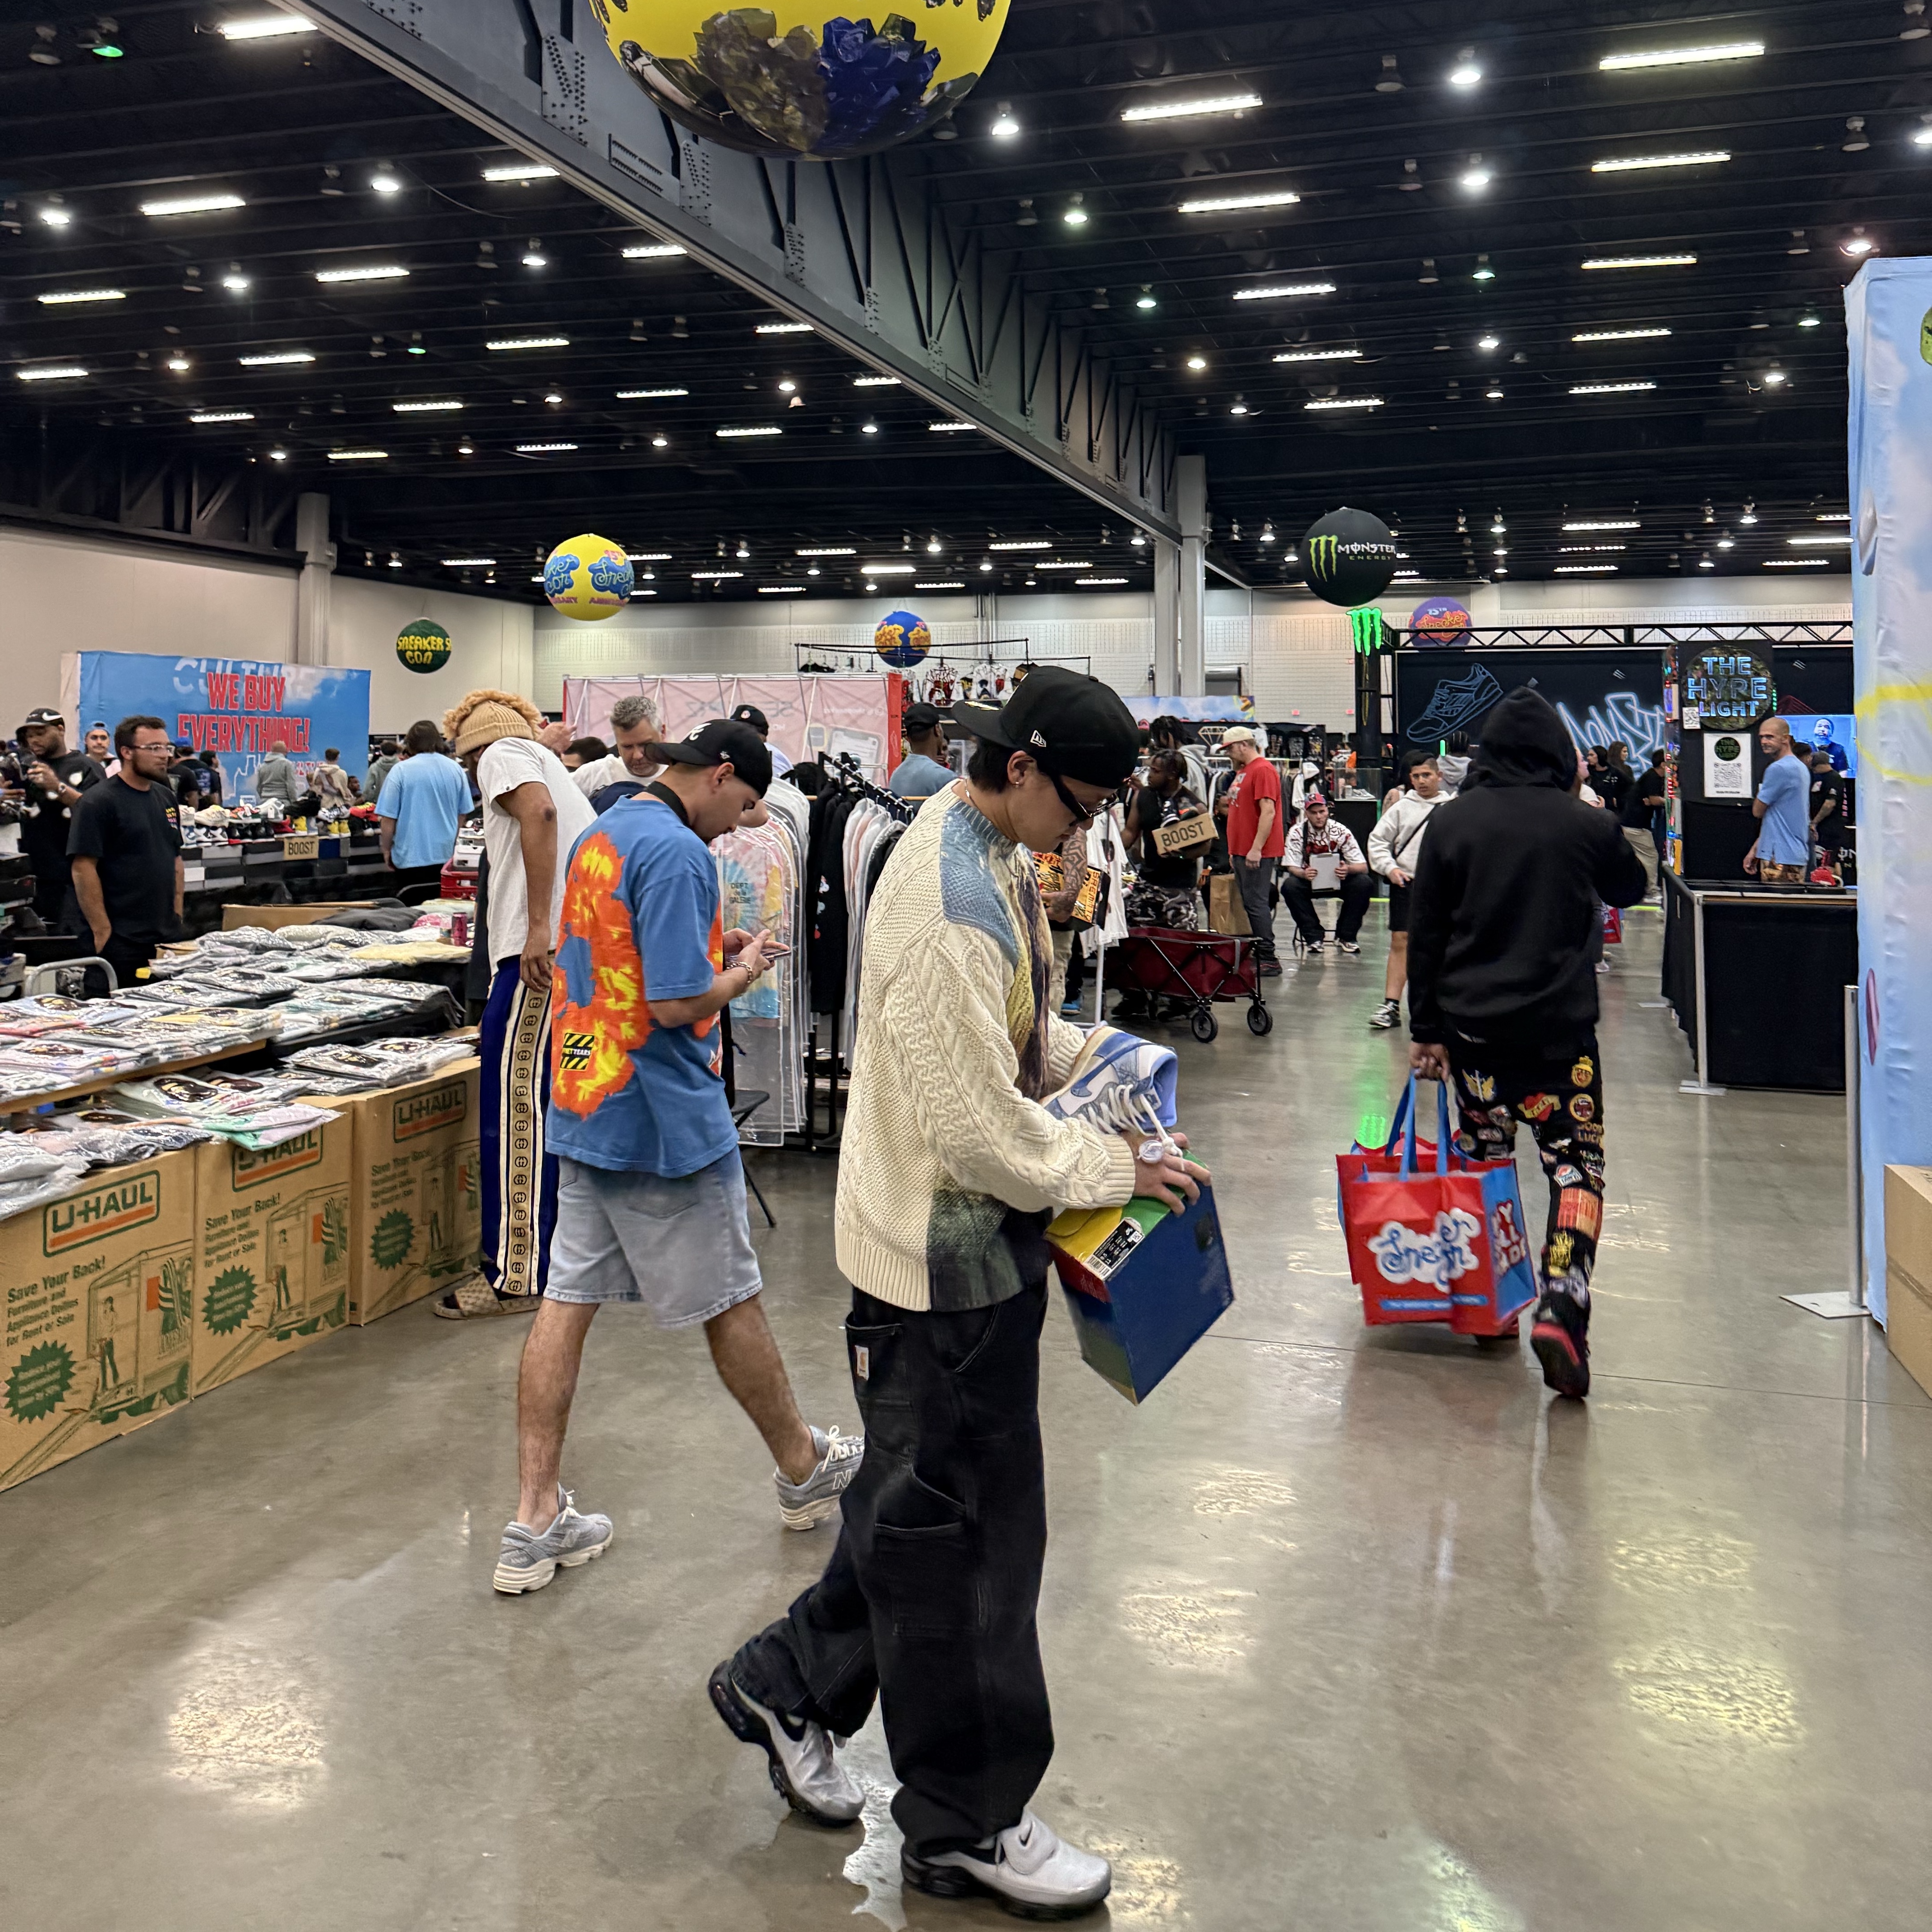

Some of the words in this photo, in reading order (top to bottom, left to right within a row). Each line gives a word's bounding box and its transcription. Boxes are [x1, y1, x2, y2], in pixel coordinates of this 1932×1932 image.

[397, 635, 444, 651] SNEAKER
[1702, 656, 1751, 675] THE
[207, 672, 240, 710] WE
[244, 674, 286, 712] BUY
[1688, 677, 1767, 699] HYPE
[1699, 701, 1759, 717] LIGHT
[178, 713, 311, 754] EVERYTHING!
[1161, 822, 1204, 846] BOOST
[288, 841, 314, 855] BOOST
[399, 1089, 462, 1124] U-HAUL
[52, 1182, 152, 1233] U-HAUL
[206, 1214, 228, 1230] Save
[8, 1283, 37, 1303] Save
[42, 1272, 69, 1290] Your
[73, 1255, 105, 1279] Back!
